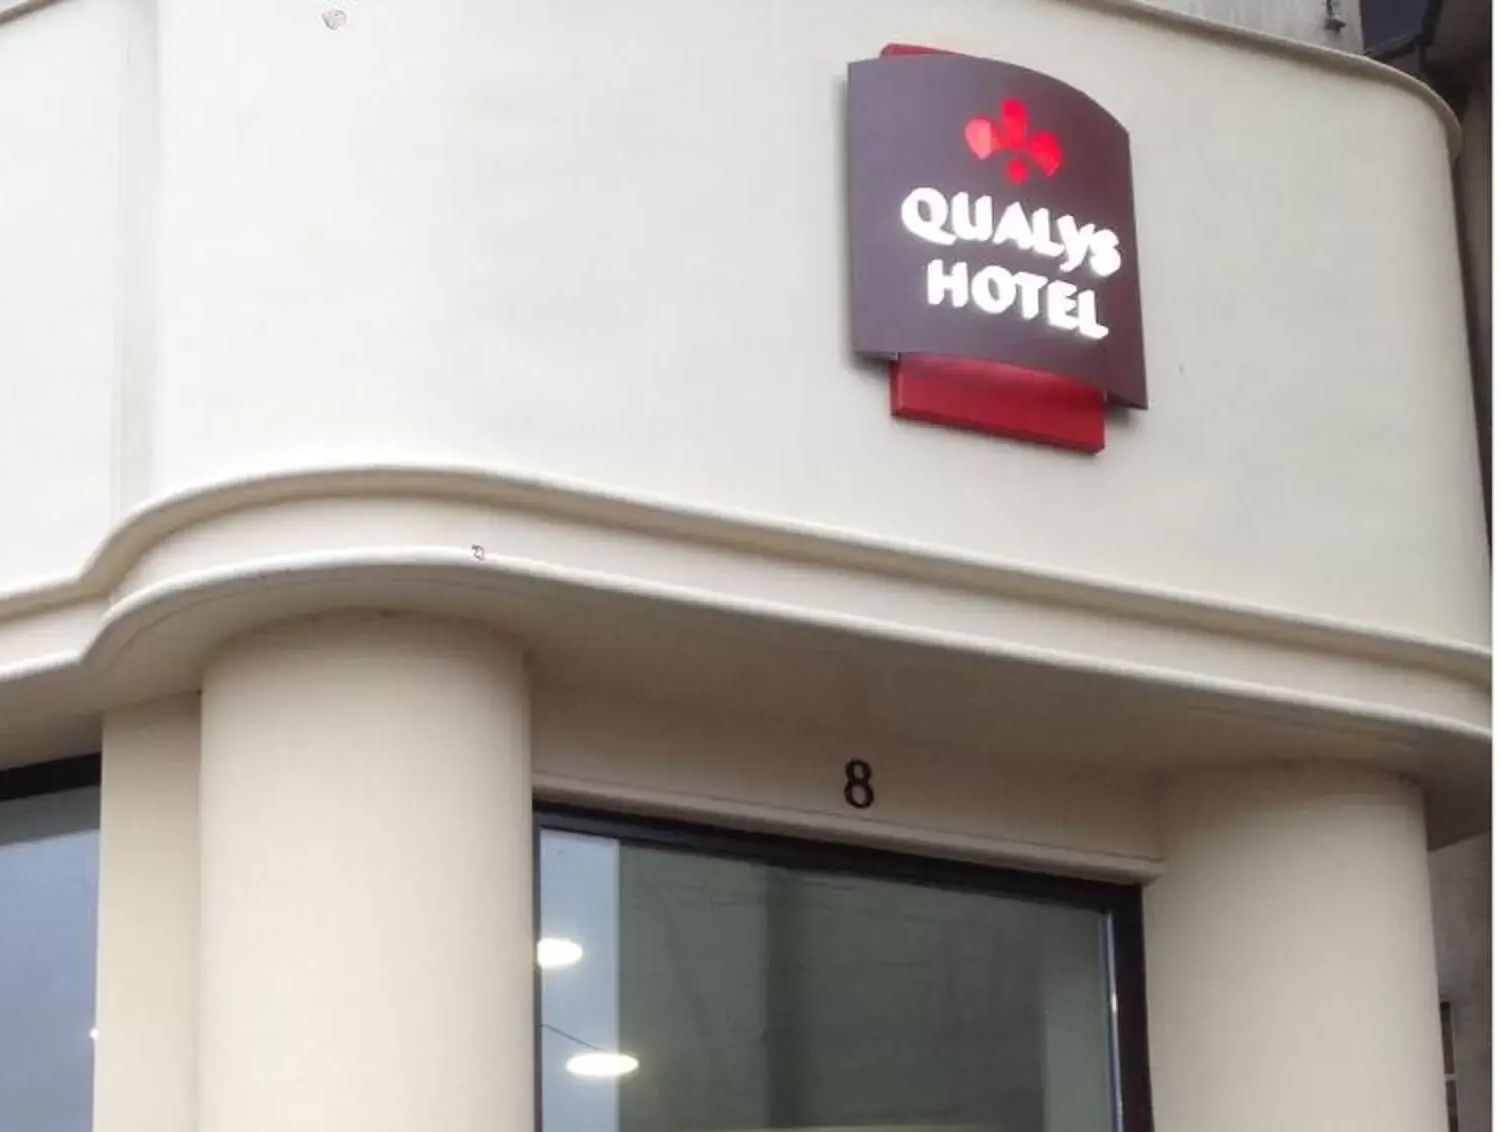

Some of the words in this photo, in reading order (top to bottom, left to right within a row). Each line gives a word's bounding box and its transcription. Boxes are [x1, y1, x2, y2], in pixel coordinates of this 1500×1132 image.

[901, 187, 1122, 277] QUALYS
[926, 259, 1109, 339] HOTEL
[844, 759, 874, 809] 8
